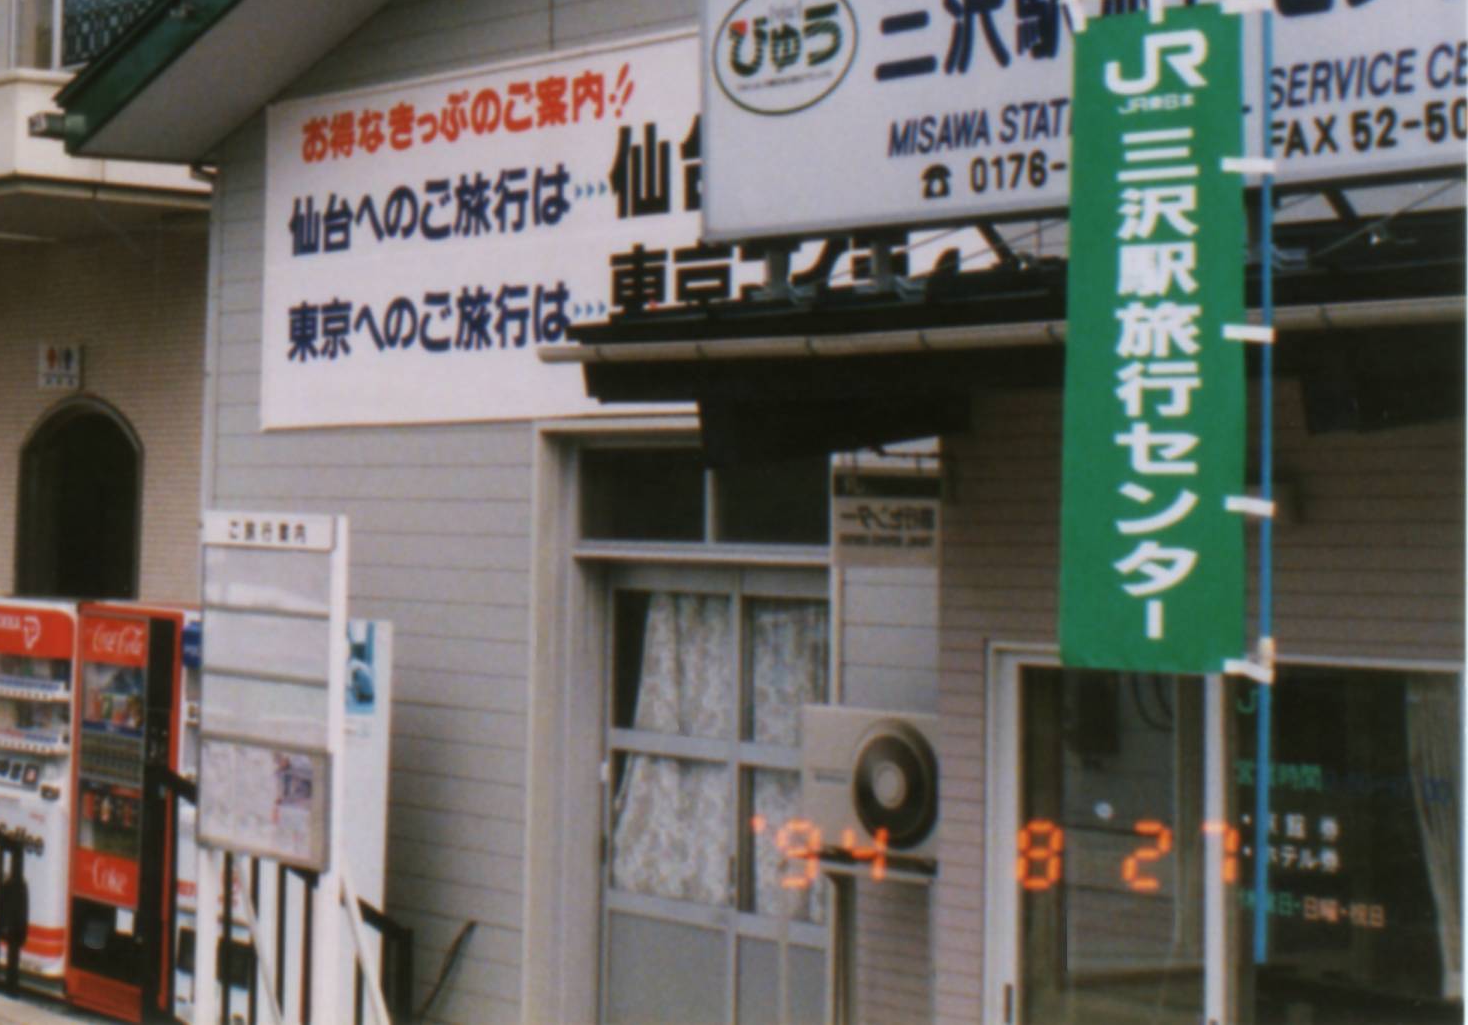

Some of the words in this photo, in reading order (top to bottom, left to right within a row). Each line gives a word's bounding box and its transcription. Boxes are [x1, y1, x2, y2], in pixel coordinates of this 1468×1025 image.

[728, 2, 843, 77] びゅう
[1105, 29, 1208, 95] JR
[887, 110, 991, 158] MISAWA
[999, 97, 1073, 143] STAT
[1270, 48, 1418, 111] SERVICE
[1270, 115, 1339, 158] FAX
[288, 163, 571, 256] 仙台へのご旅行は
[287, 282, 572, 363] 東京へのご旅行は
[1113, 127, 1201, 640] 三沢駅旅行センター
